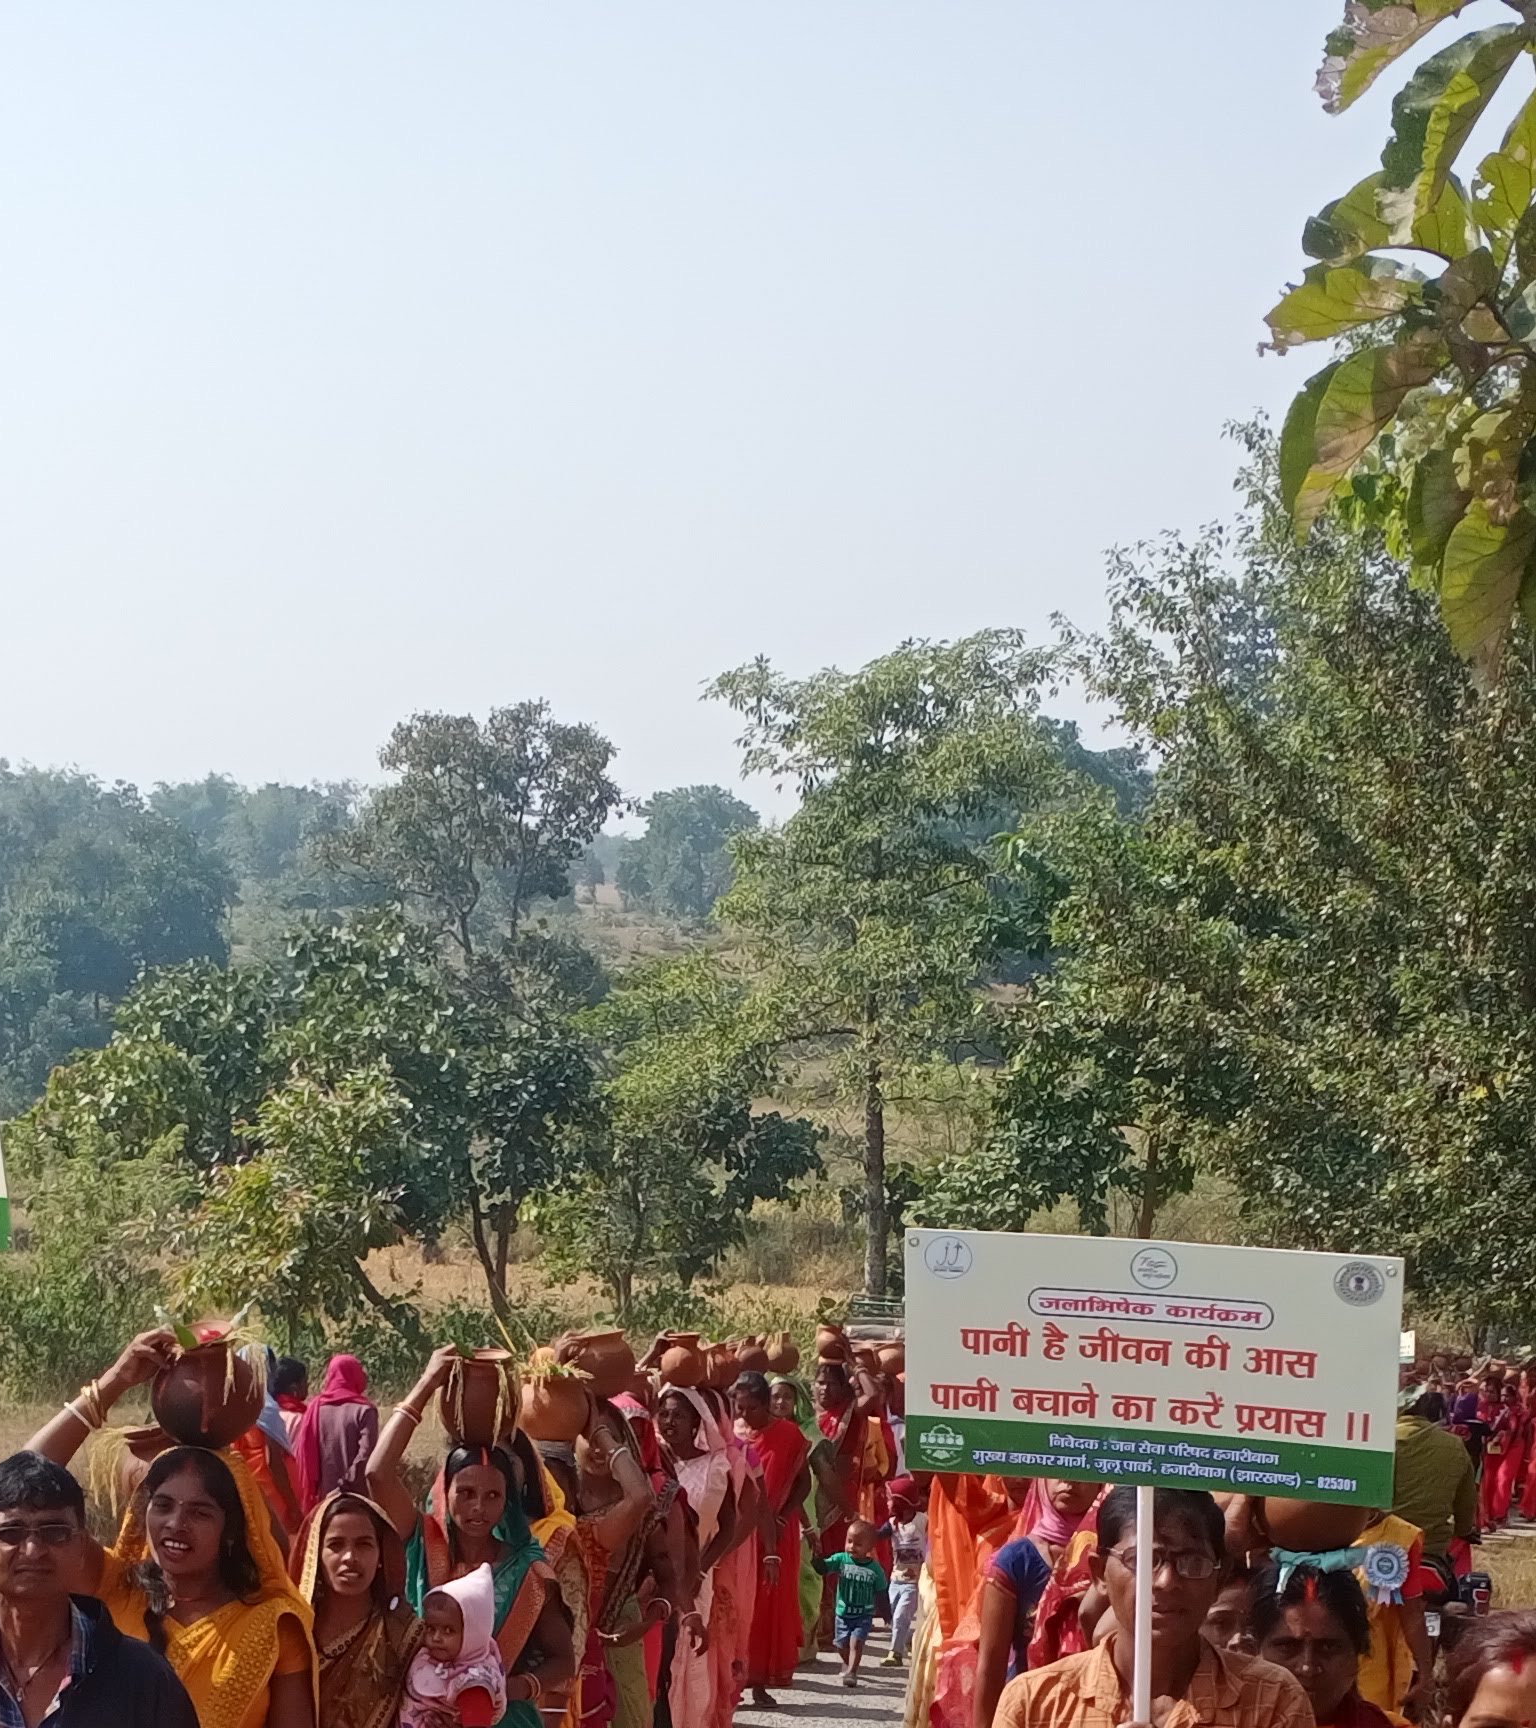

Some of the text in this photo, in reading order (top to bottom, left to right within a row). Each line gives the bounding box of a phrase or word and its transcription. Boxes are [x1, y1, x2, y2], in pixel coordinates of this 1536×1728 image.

[1038, 1294, 1262, 1326] जलाभिषेक कार्यक्रम
[960, 1321, 1318, 1379] पानी है जीवन की आस
[930, 1377, 1000, 1413] पानी
[1011, 1383, 1099, 1419] बचाने
[1111, 1394, 1156, 1423] का
[1168, 1392, 1224, 1430] करें
[1235, 1403, 1326, 1439] प्रयास
[1049, 1433, 1099, 1450] निवेदक
[1110, 1440, 1136, 1454] जन
[1138, 1439, 1165, 1456] सेवा
[972, 1449, 1006, 1466] मुख्य
[1317, 1476, 1357, 1492] 825301
